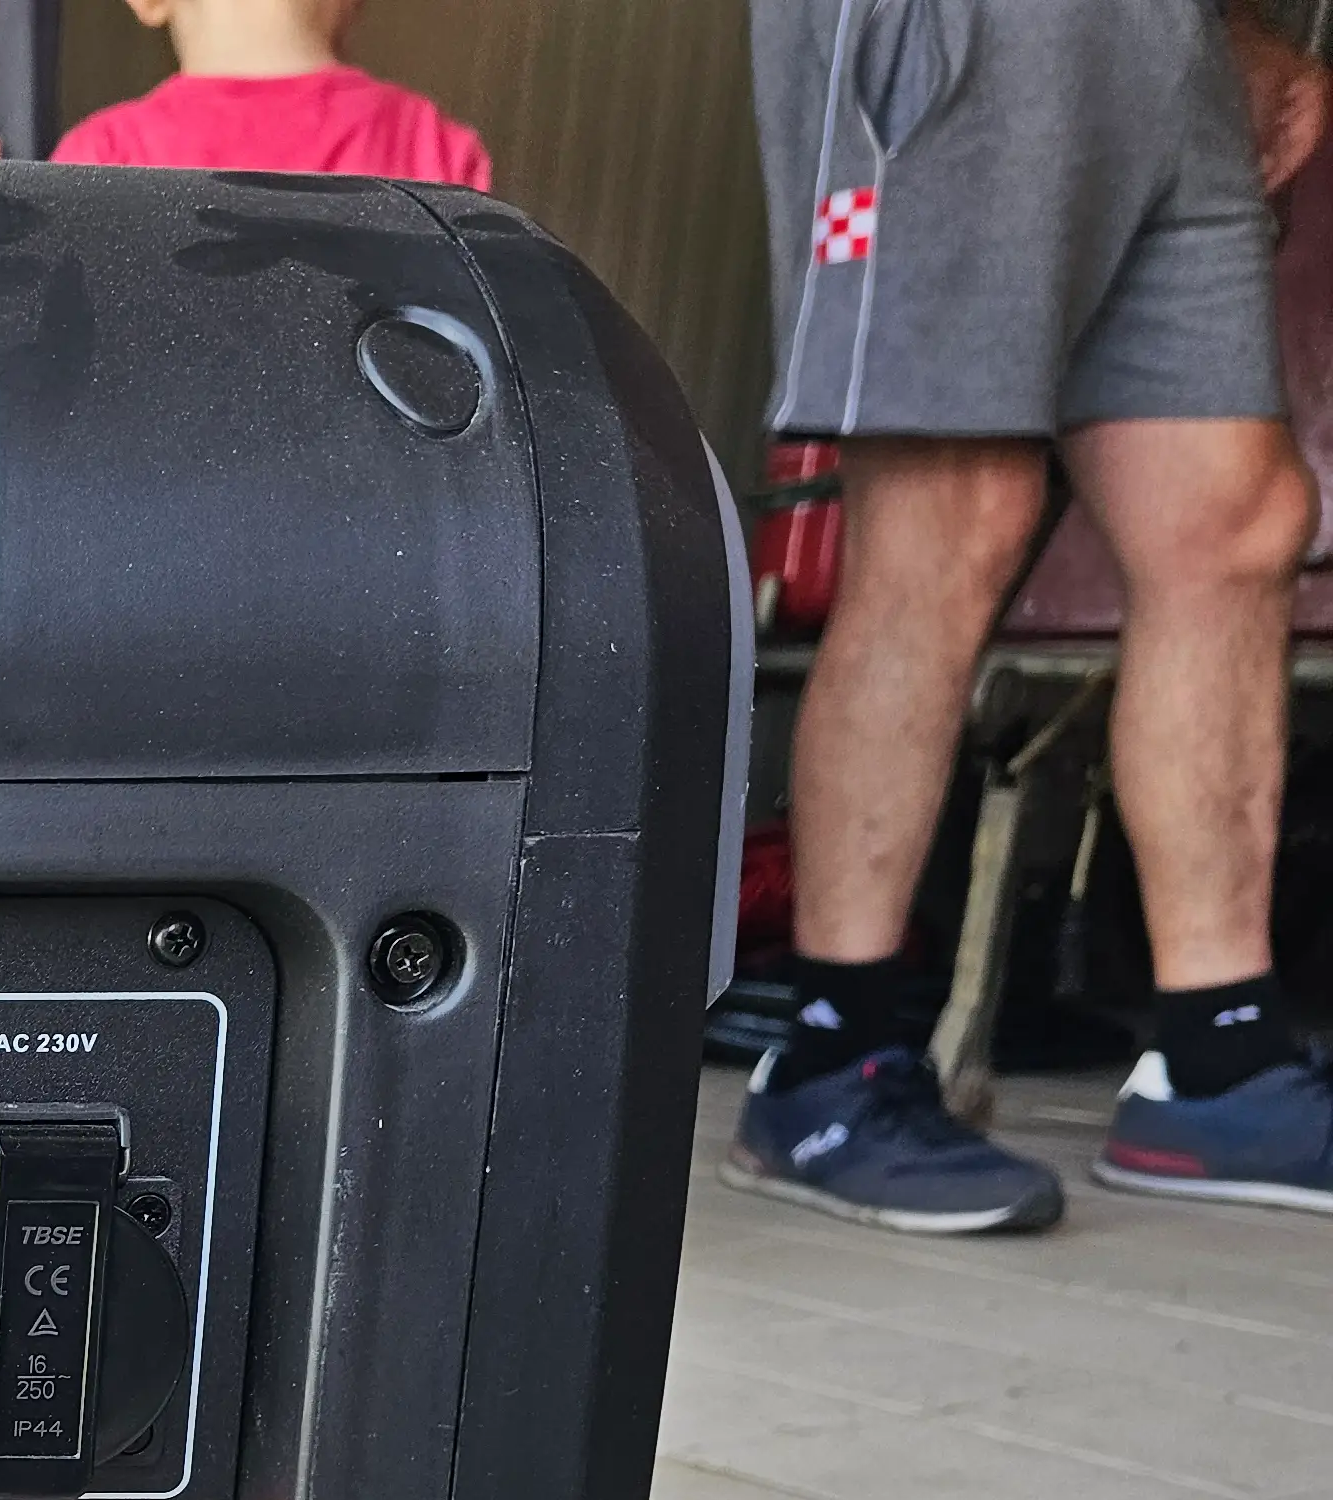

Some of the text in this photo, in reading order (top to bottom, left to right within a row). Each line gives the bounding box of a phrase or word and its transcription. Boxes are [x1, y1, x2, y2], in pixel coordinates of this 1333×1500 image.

[36, 1033, 99, 1053] 230V
[21, 1226, 84, 1246] TBSE
[13, 1421, 63, 1438] IP44
